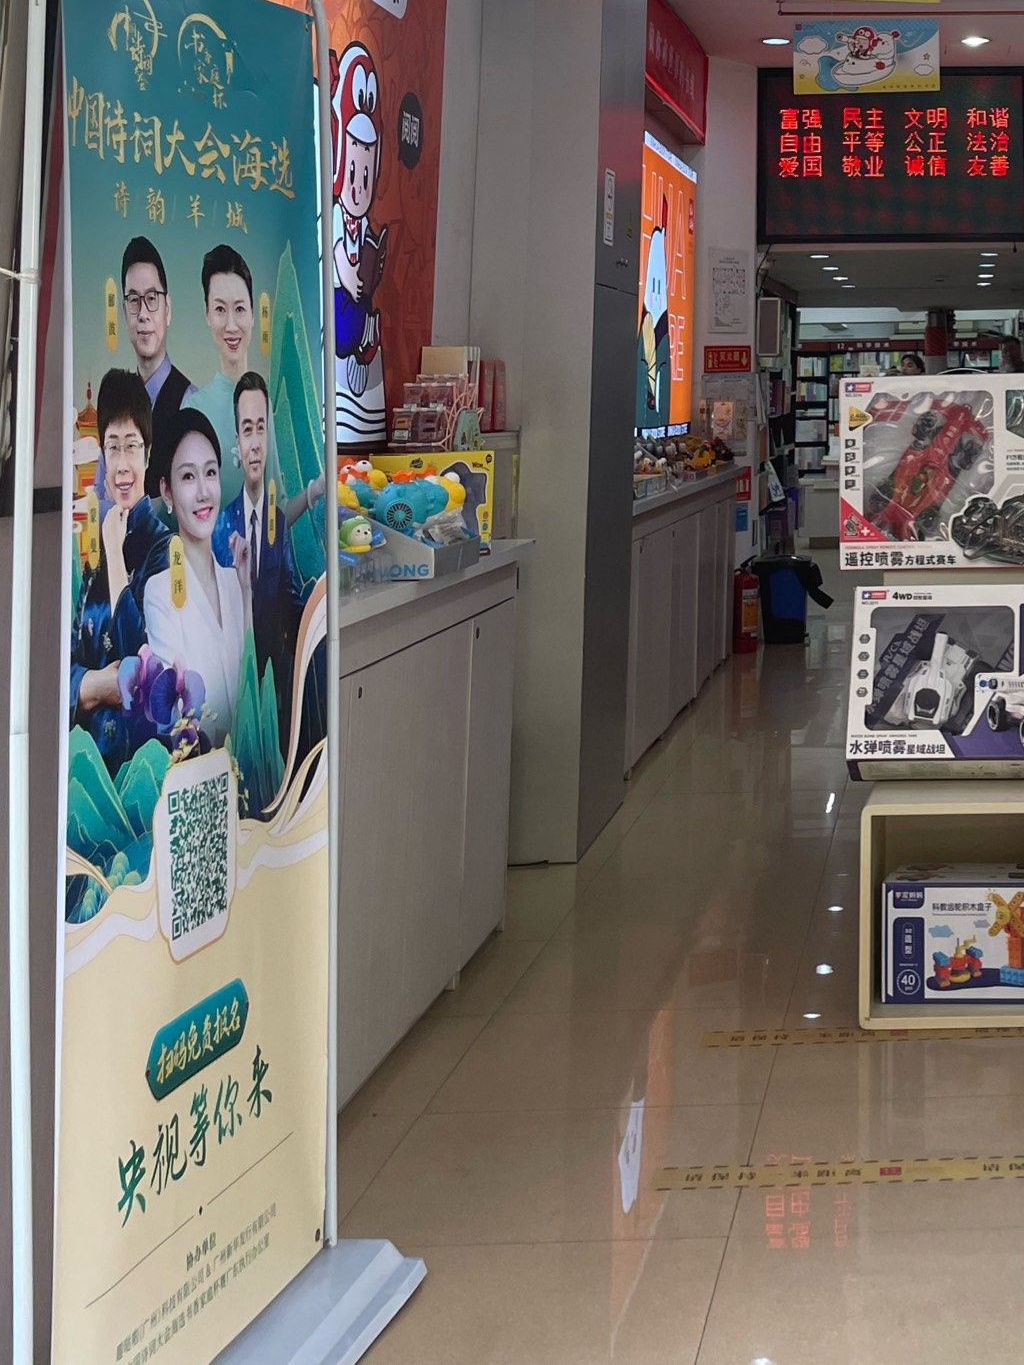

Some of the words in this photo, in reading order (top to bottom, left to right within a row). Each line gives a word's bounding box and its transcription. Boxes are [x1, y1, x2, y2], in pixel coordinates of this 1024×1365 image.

[779, 108, 823, 130] 富强
[842, 108, 886, 129] 民主
[904, 108, 948, 129] 文明
[966, 108, 1010, 129] 和谐
[779, 133, 822, 154] 自由
[842, 133, 886, 153] 平等
[904, 133, 948, 153] 公正
[966, 133, 1010, 153] 法治
[779, 156, 823, 178] 爱国
[842, 156, 886, 178] 敬业
[904, 156, 948, 178] 诚信
[966, 156, 1010, 177] 友善
[845, 551, 957, 567] 遥控喷雾方程式赛车
[172, 551, 184, 595] 龙洋
[892, 591, 913, 601] 4WD
[849, 738, 947, 756] 水弹喷雾星域战坦
[900, 974, 916, 985] 40
[156, 996, 242, 1084] 扫码免费报名
[117, 1043, 273, 1229] 央视等你来
